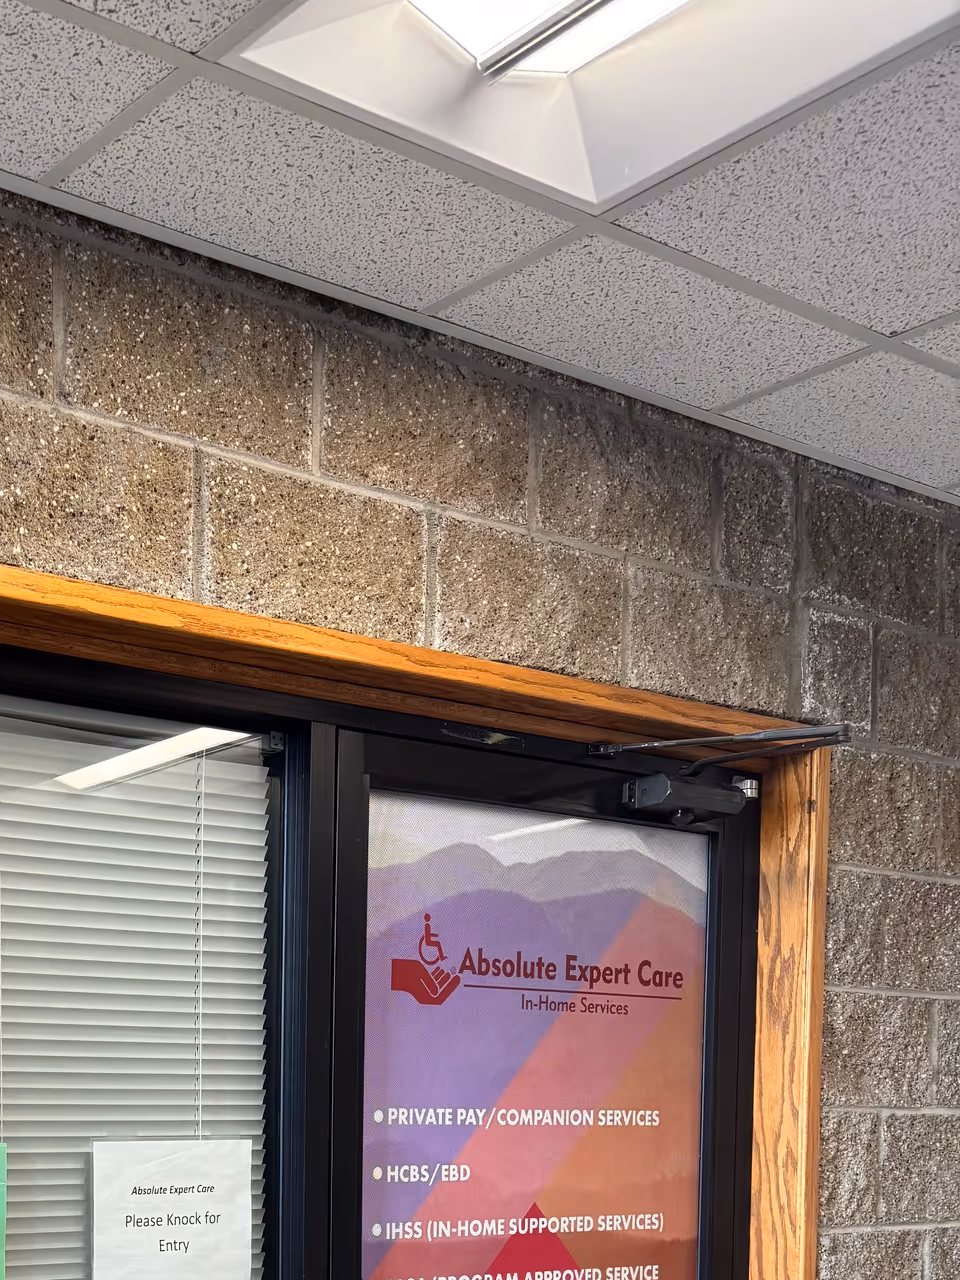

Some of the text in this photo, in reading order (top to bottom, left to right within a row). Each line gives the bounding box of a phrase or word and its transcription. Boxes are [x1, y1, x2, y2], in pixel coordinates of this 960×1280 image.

[458, 947, 684, 990] Absolute Expert Care
[521, 993, 629, 1016] In-Home Services
[387, 1107, 660, 1129] PRIVATE PAY/COMPANION SERVICES
[386, 1163, 471, 1186] HCBS/EBD
[130, 1184, 215, 1196] Absolute Expert Care
[125, 1210, 221, 1228] Please Knock for
[386, 1212, 665, 1242] IHSS (IN-HOME SUPPORTED SERVICES)
[159, 1239, 190, 1254] Entry
